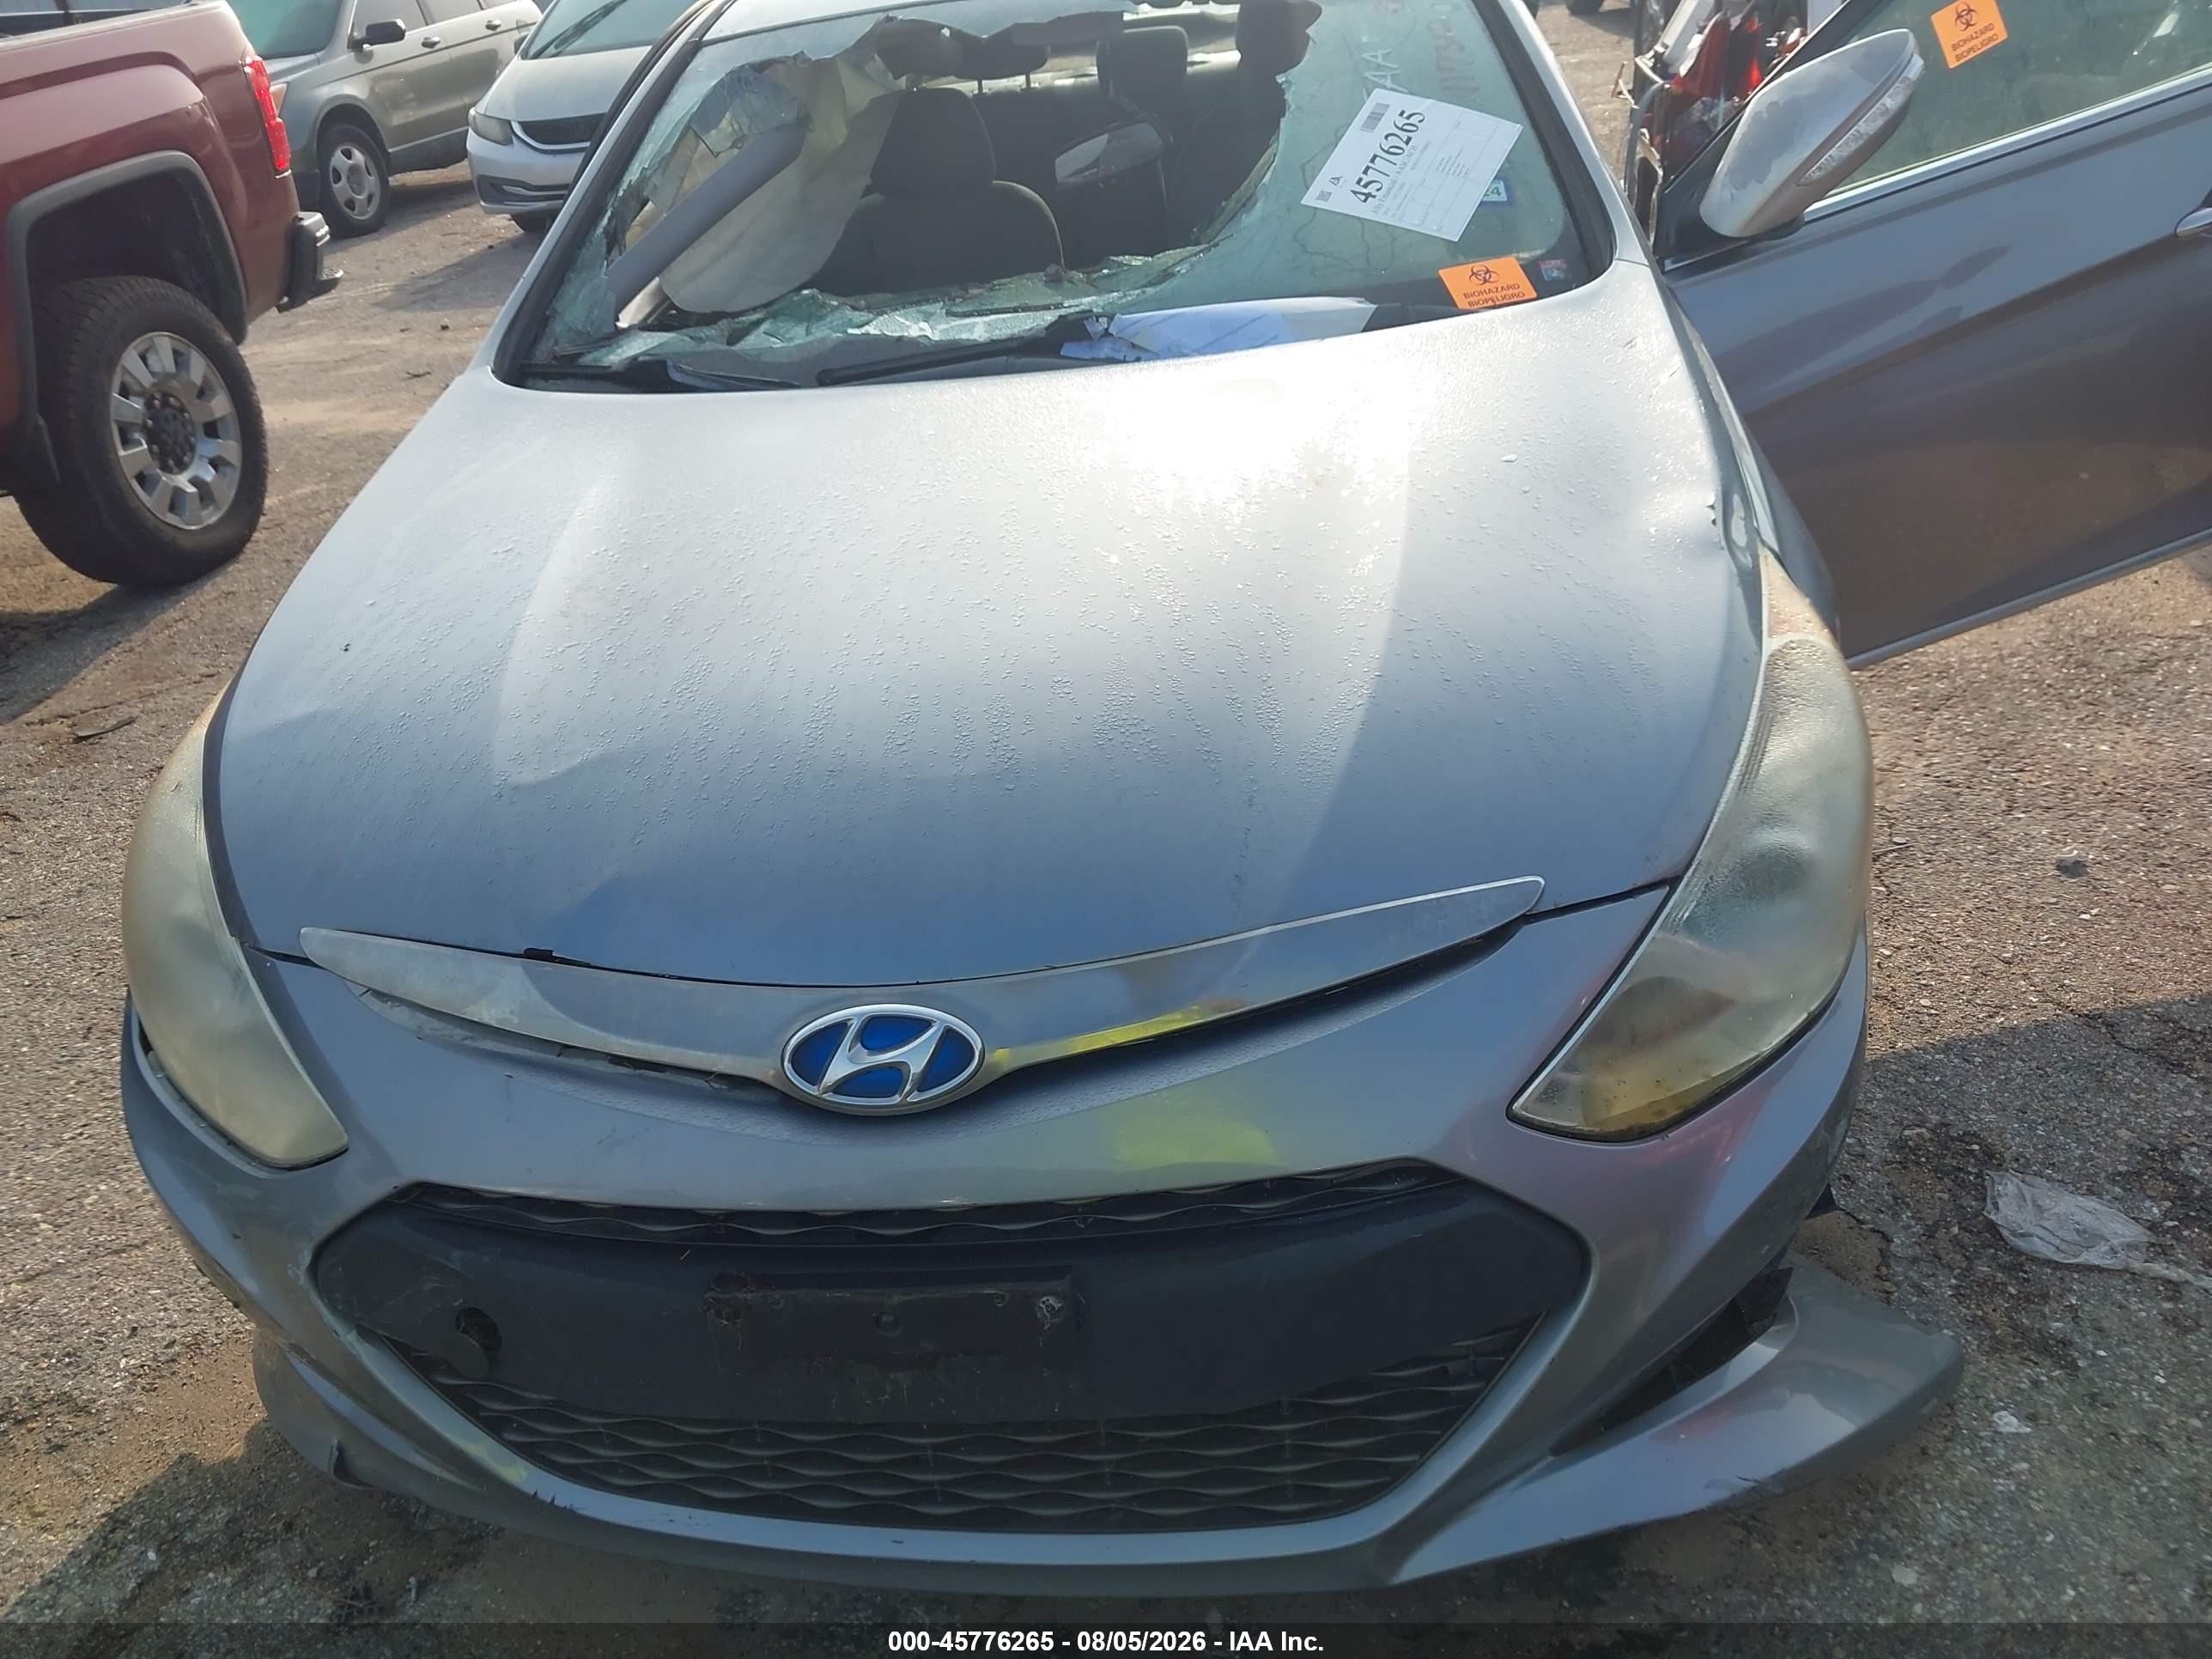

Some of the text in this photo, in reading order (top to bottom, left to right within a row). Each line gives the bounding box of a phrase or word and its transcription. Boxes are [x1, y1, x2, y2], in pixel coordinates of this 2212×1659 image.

[1951, 23, 1995, 51] BIOHAZARD
[1954, 33, 1999, 62] BIOPELIGRO
[1349, 110, 1425, 204] 45776265
[1463, 283, 1520, 299] BIOHAZARD
[1468, 291, 1526, 307] BIOPELIGRO
